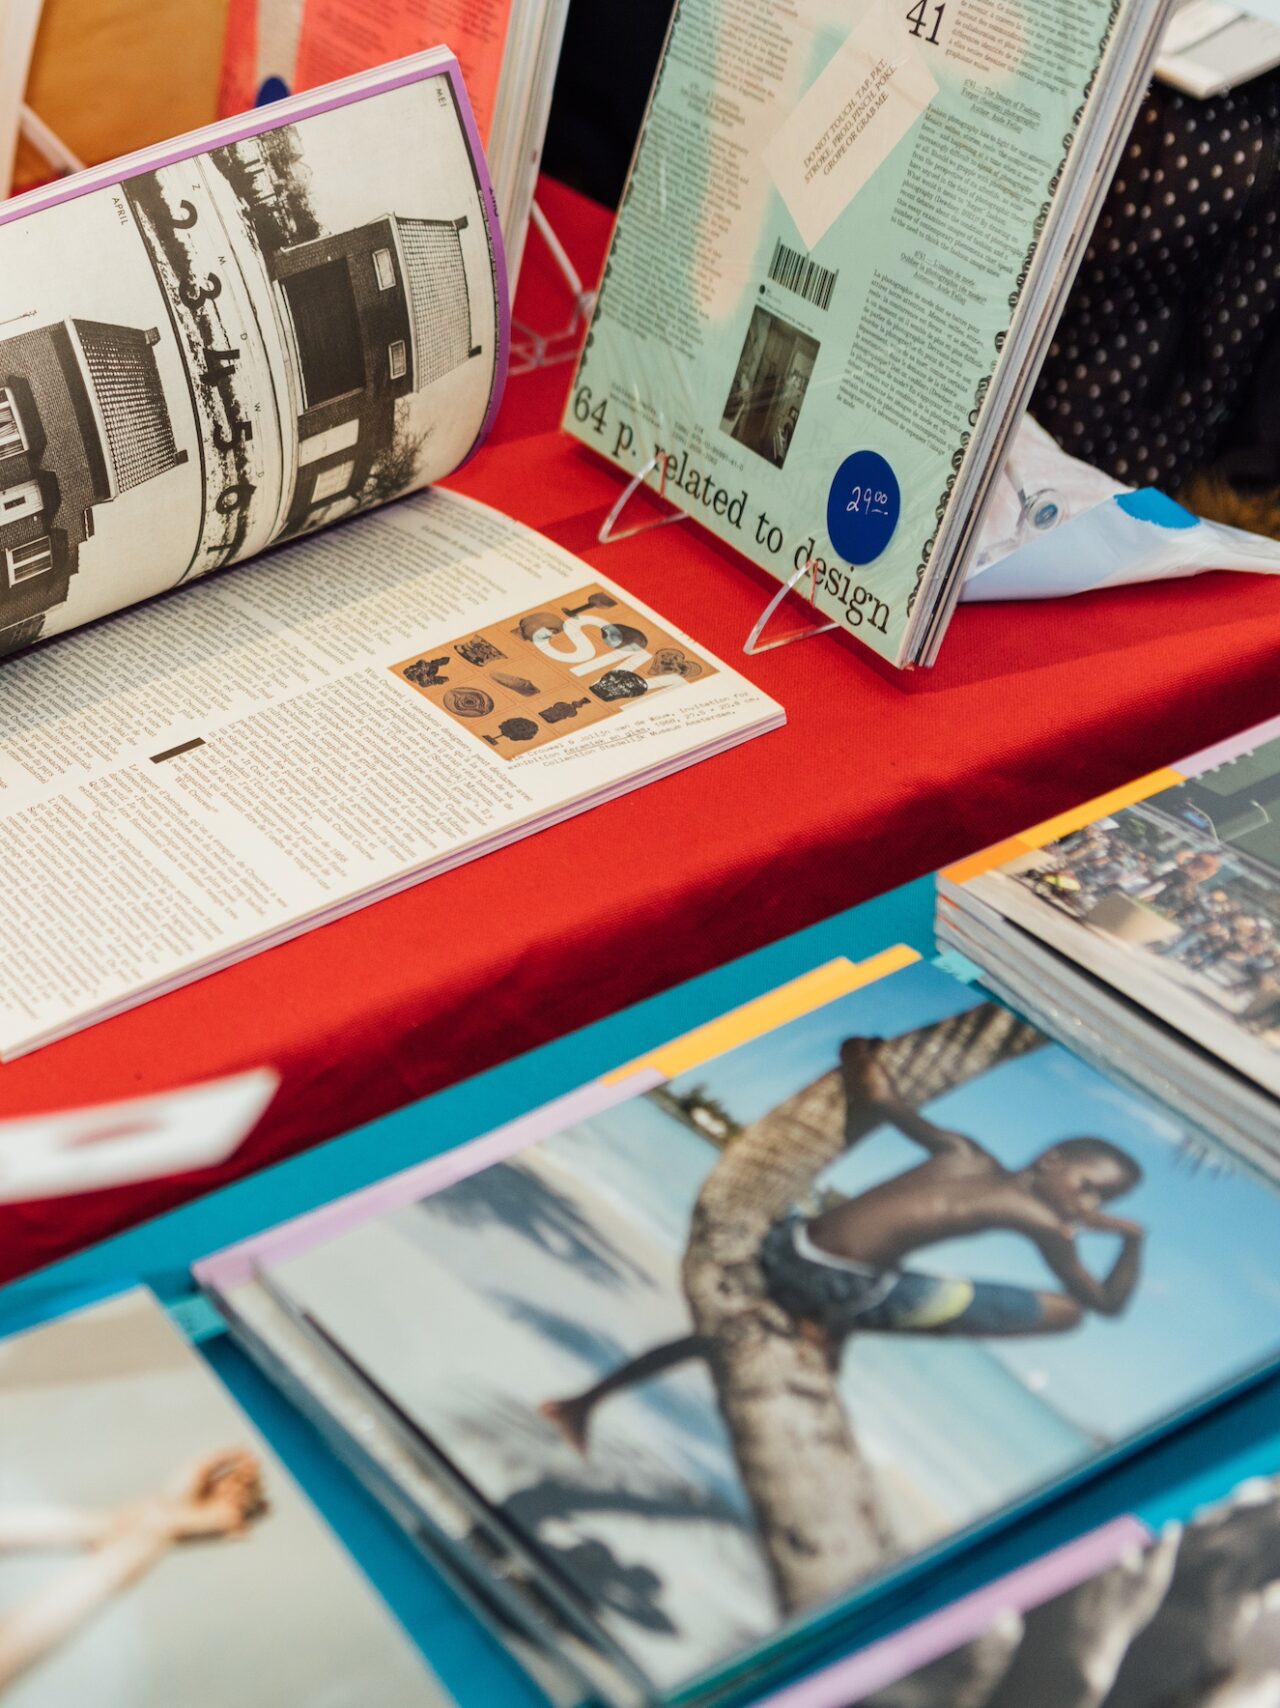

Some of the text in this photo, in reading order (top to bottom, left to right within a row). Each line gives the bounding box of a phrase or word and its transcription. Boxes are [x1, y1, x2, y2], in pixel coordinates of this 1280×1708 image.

[906, 0, 946, 46] 41
[813, 130, 832, 153] NOT
[111, 196, 130, 227] APRIL
[573, 386, 609, 435] 64
[614, 420, 637, 457] p.
[652, 443, 748, 531] related
[755, 513, 784, 555] to
[793, 538, 892, 634] design
